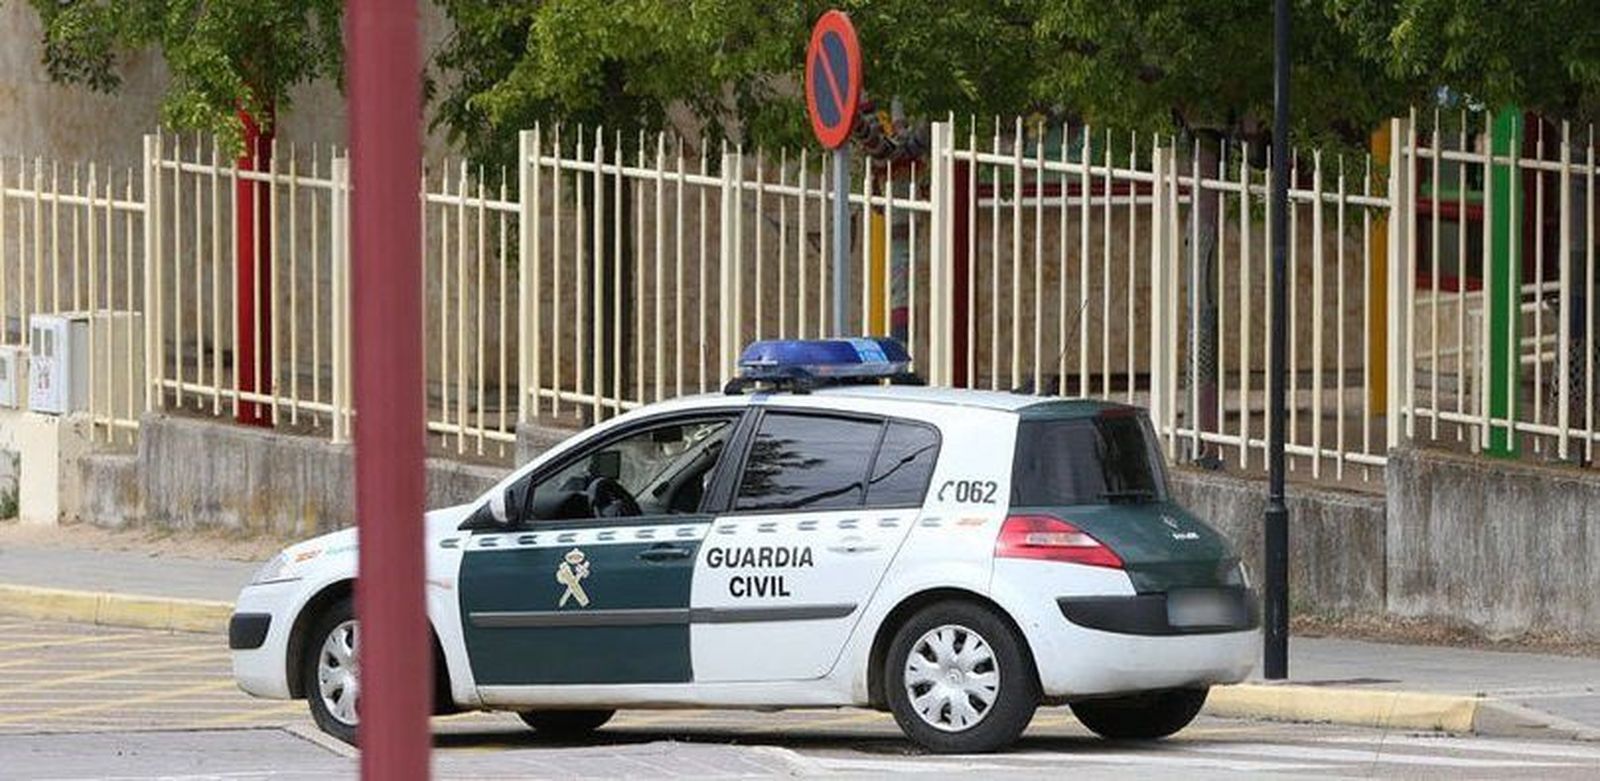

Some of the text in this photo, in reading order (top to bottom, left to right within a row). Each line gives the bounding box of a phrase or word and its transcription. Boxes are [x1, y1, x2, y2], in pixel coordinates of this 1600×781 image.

[955, 480, 998, 504] 062
[706, 546, 814, 569] GUARDIA
[728, 575, 791, 598] CIVIL
